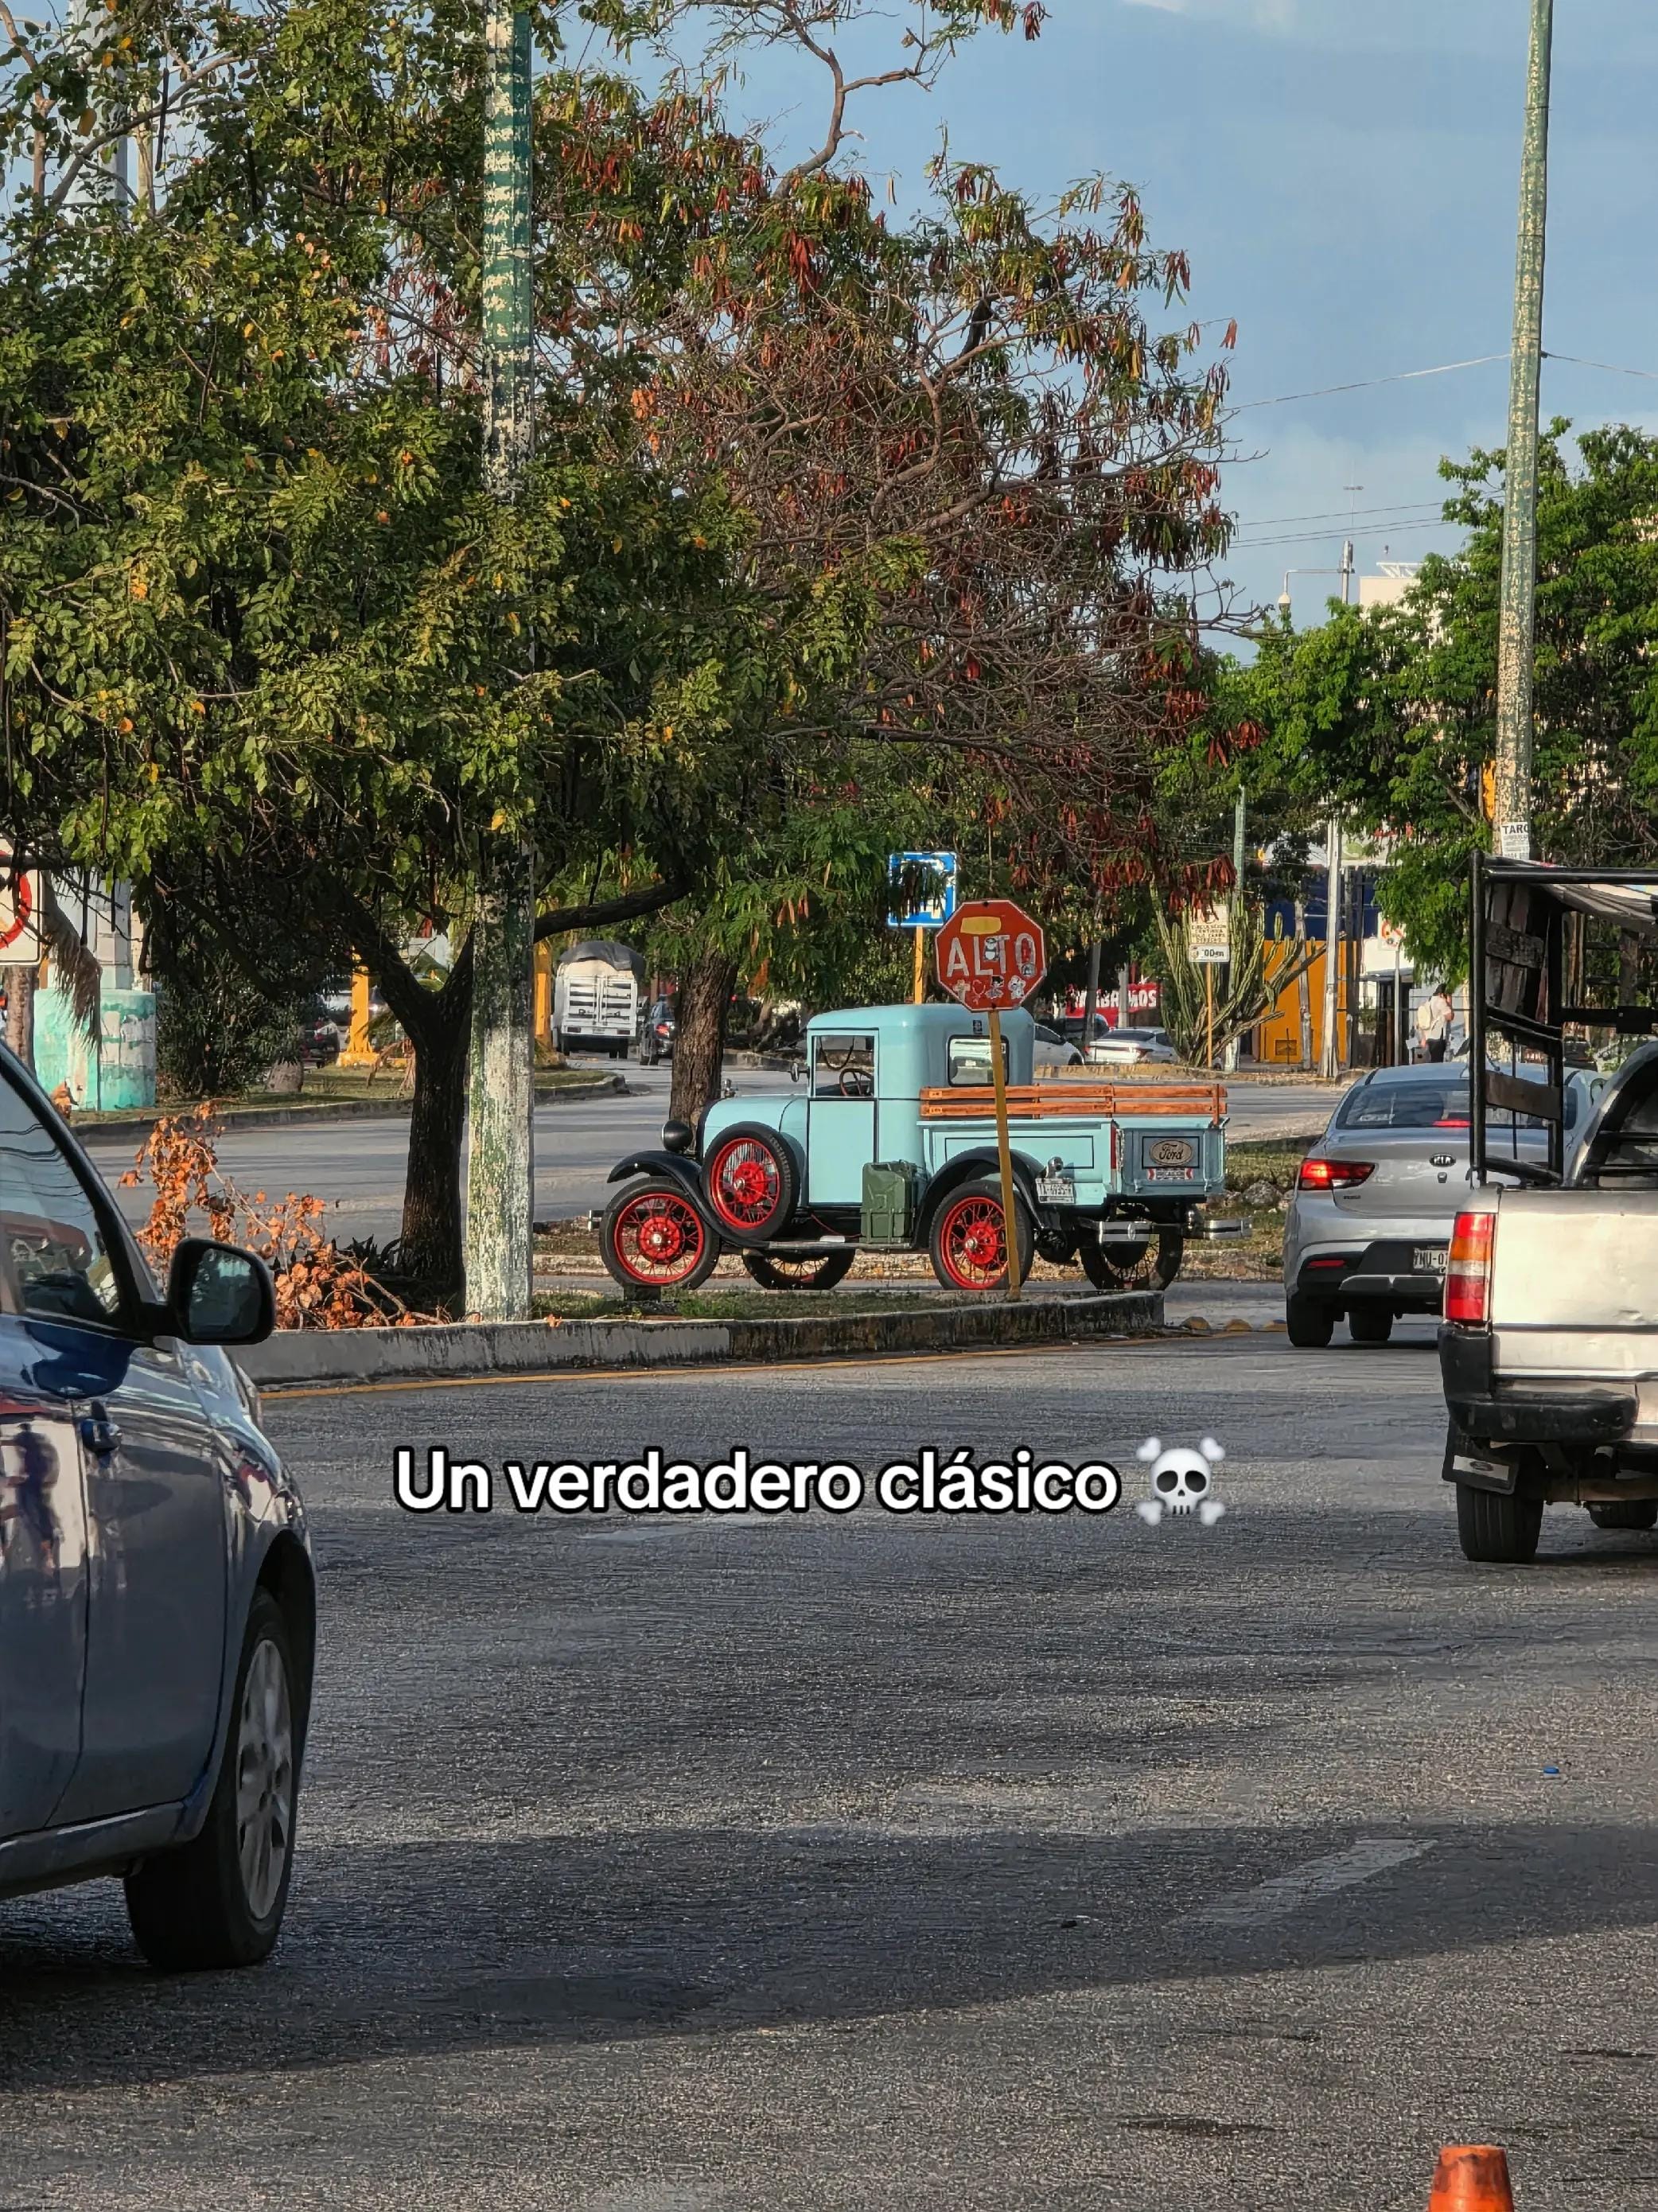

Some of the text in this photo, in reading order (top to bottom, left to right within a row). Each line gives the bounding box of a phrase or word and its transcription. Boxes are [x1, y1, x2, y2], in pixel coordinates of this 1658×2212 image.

[946, 932, 1037, 978] ALTO
[1158, 1143, 1184, 1160] Ford
[1433, 1155, 1452, 1165] KIA
